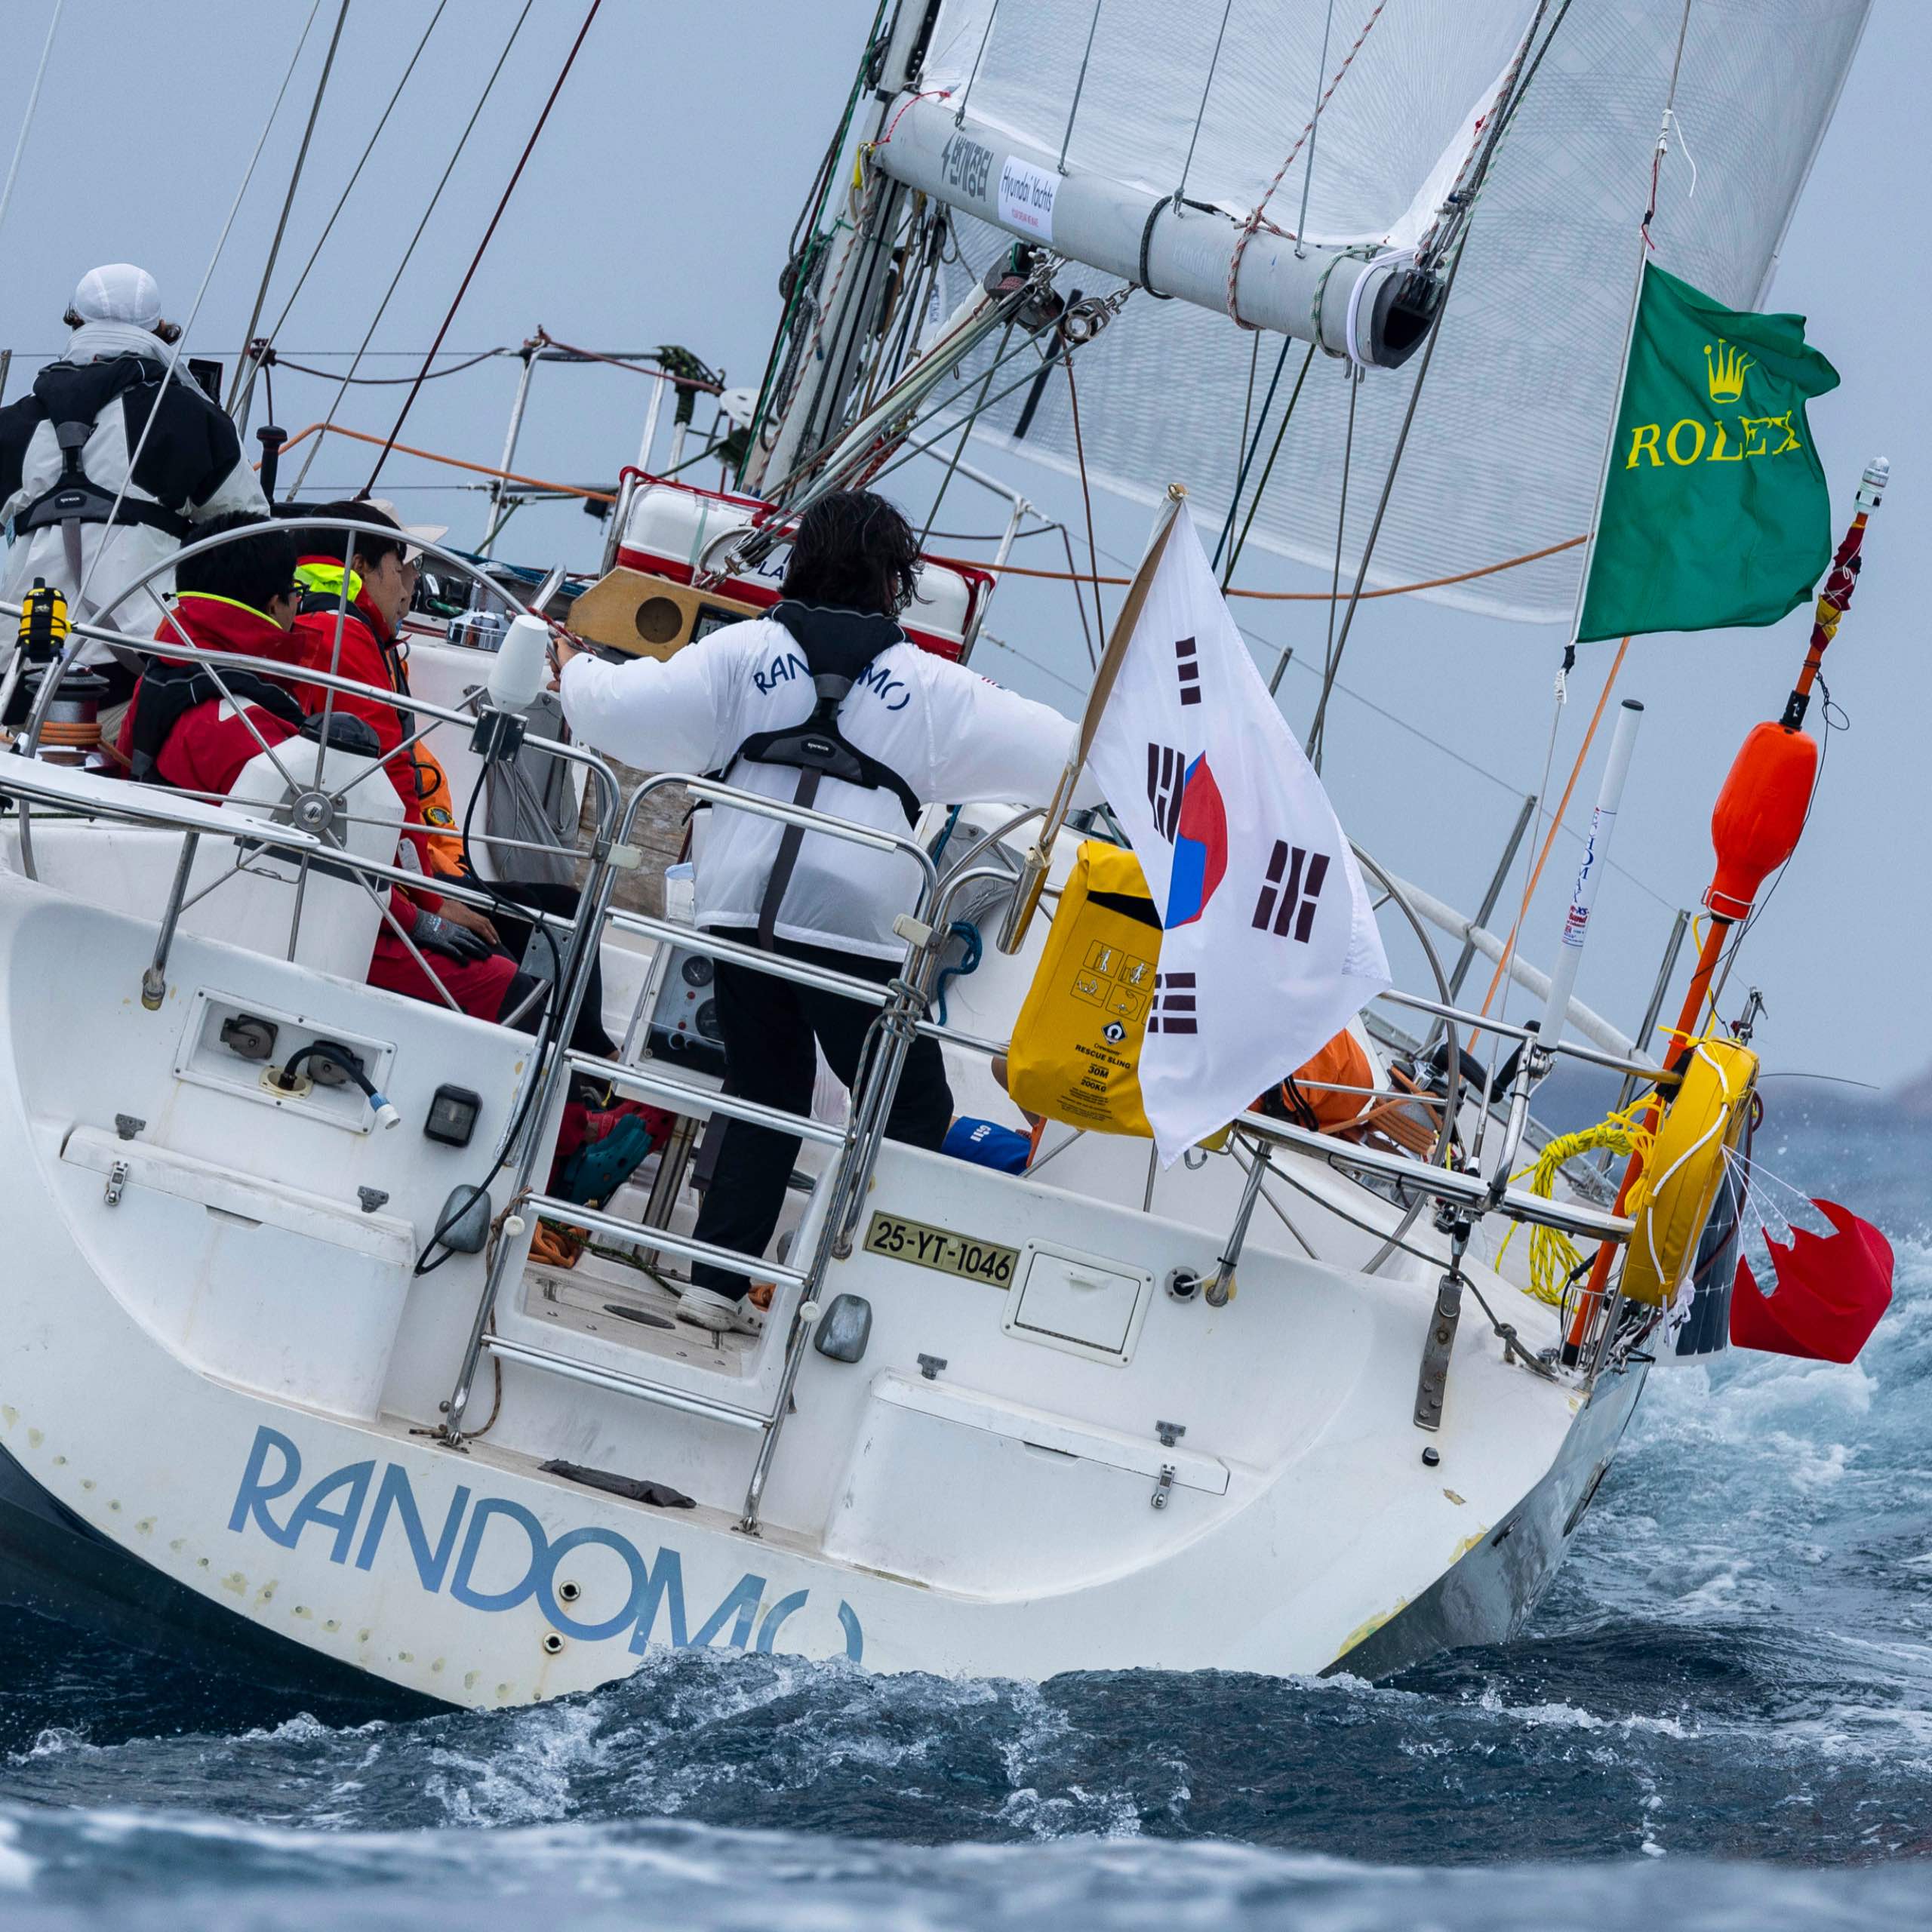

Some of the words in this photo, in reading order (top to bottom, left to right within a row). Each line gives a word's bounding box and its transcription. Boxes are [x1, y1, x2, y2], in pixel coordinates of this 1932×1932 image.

[950, 136, 994, 202] 번개장터
[1001, 165, 1033, 202] Hyundai
[1032, 178, 1054, 212] Yachts
[1625, 410, 1801, 469] ROLEX
[1075, 1044, 1106, 1061] RESCUE
[1107, 1056, 1131, 1069] SLING
[1088, 1066, 1109, 1078] 30M
[1081, 1079, 1106, 1092] 200KG
[874, 1221, 1012, 1281] 25-YT-1046
